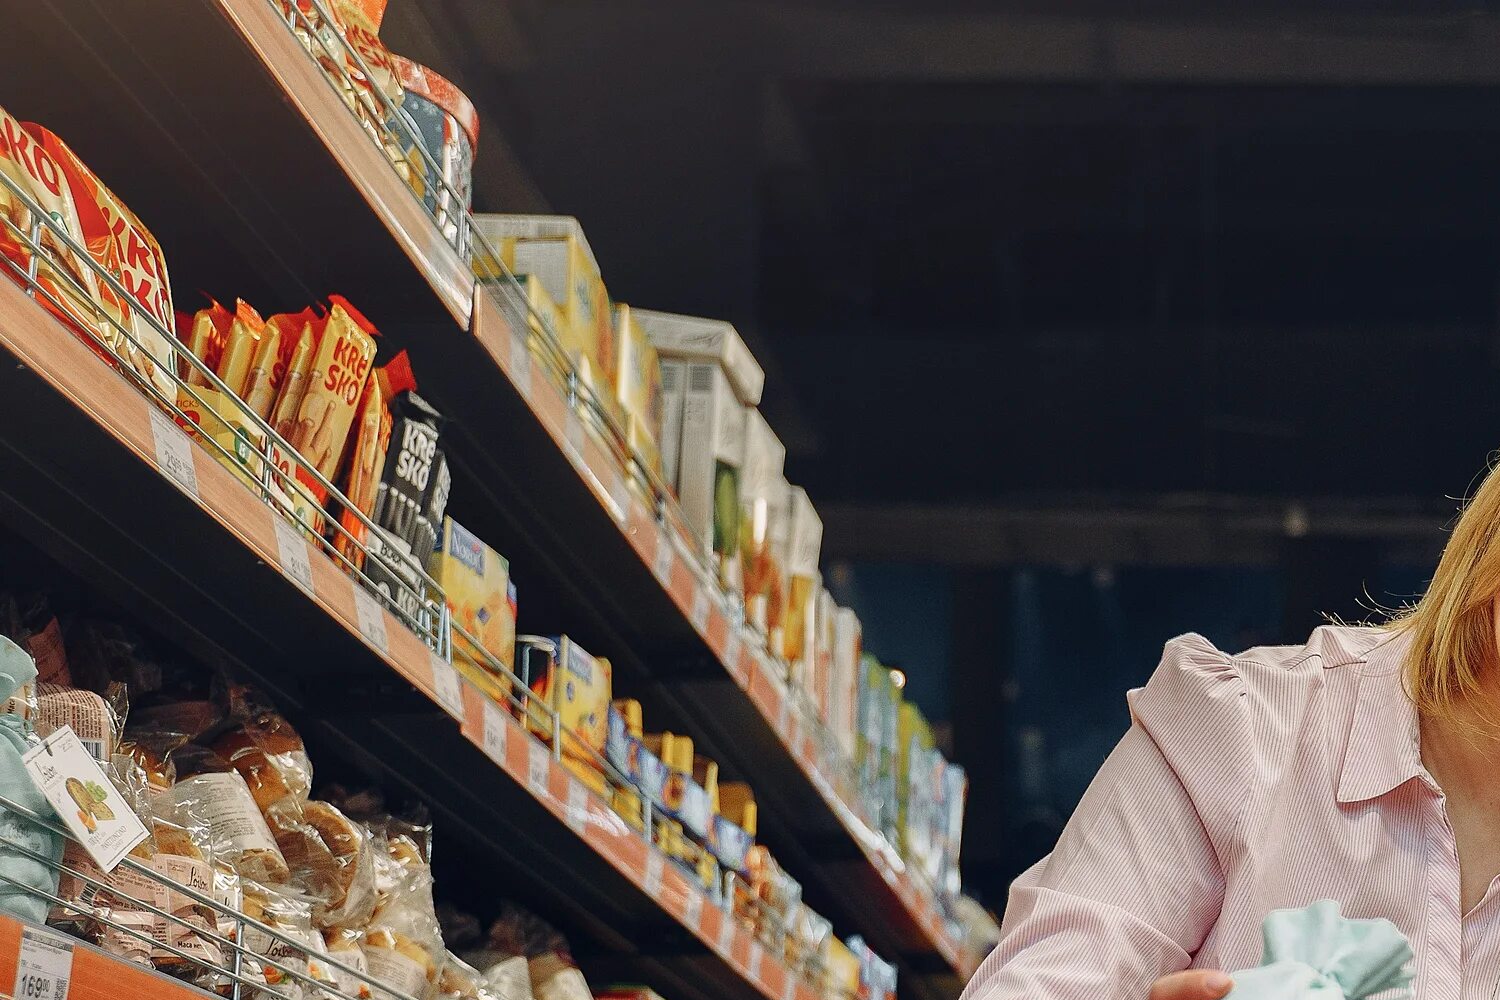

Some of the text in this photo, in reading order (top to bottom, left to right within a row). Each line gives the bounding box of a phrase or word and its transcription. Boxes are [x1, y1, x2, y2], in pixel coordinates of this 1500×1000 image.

[0, 117, 61, 197] KO
[324, 364, 360, 407] SKO
[396, 449, 431, 492] SKO
[22, 974, 42, 999] 169
